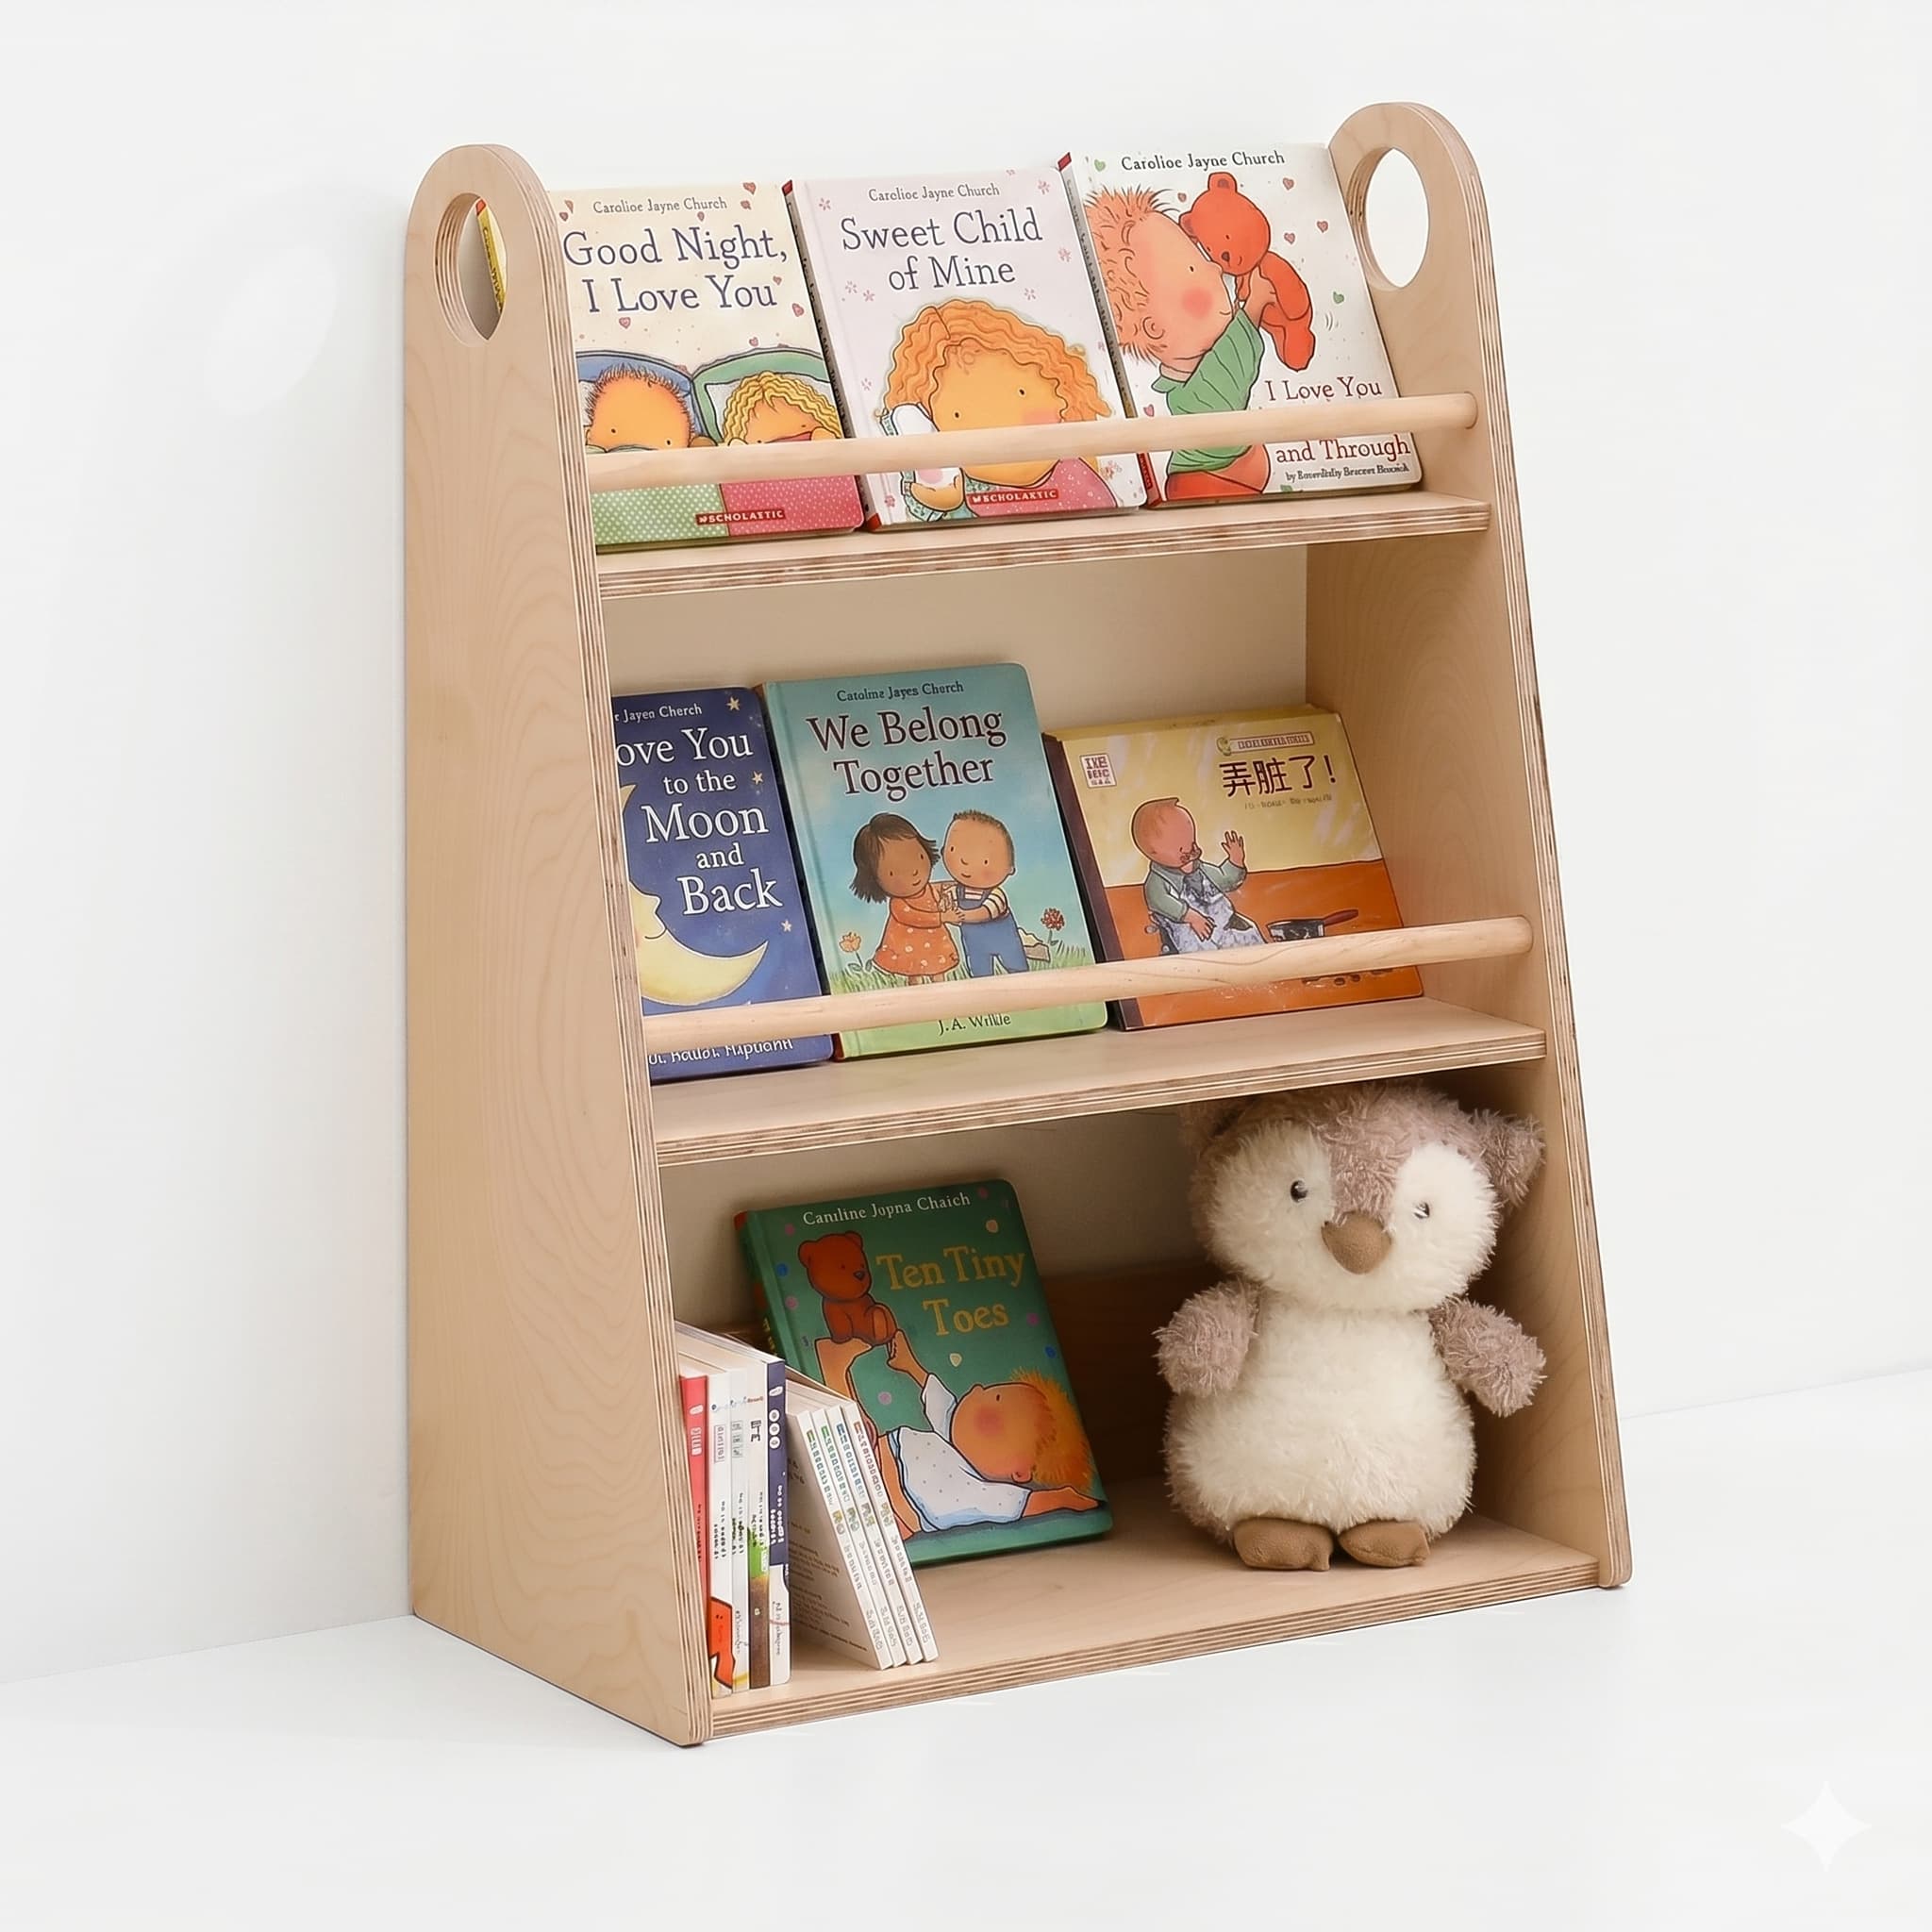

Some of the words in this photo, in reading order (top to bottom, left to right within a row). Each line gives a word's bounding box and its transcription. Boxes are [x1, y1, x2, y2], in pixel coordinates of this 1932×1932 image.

[1188, 153, 1227, 171] Jayne
[1231, 150, 1285, 166] Church
[683, 196, 727, 209] Church
[958, 183, 1000, 197] Church
[562, 228, 662, 265] Good
[672, 225, 787, 269] Night,
[840, 217, 945, 250] Sweet
[954, 208, 1043, 243] Child
[888, 256, 919, 291] of
[928, 255, 1016, 289] Mine
[582, 279, 600, 312] I
[610, 277, 700, 312] Love
[705, 275, 777, 308] You
[1265, 380, 1275, 401] I
[1282, 379, 1335, 400] Love
[1337, 376, 1383, 397] You
[1275, 441, 1315, 462] and
[1320, 434, 1411, 462] Through
[615, 739, 675, 767] ove
[680, 727, 754, 760] You
[806, 715, 871, 752] We
[876, 706, 1008, 747] Belong
[663, 776, 689, 795] to
[695, 770, 737, 792] the
[833, 750, 994, 802] Together
[641, 803, 769, 843] Moon
[696, 842, 744, 869] and
[676, 868, 784, 916] Back
[875, 1254, 946, 1291] Ten
[943, 1245, 1026, 1289] Tiny
[922, 1299, 1009, 1337] Toes
